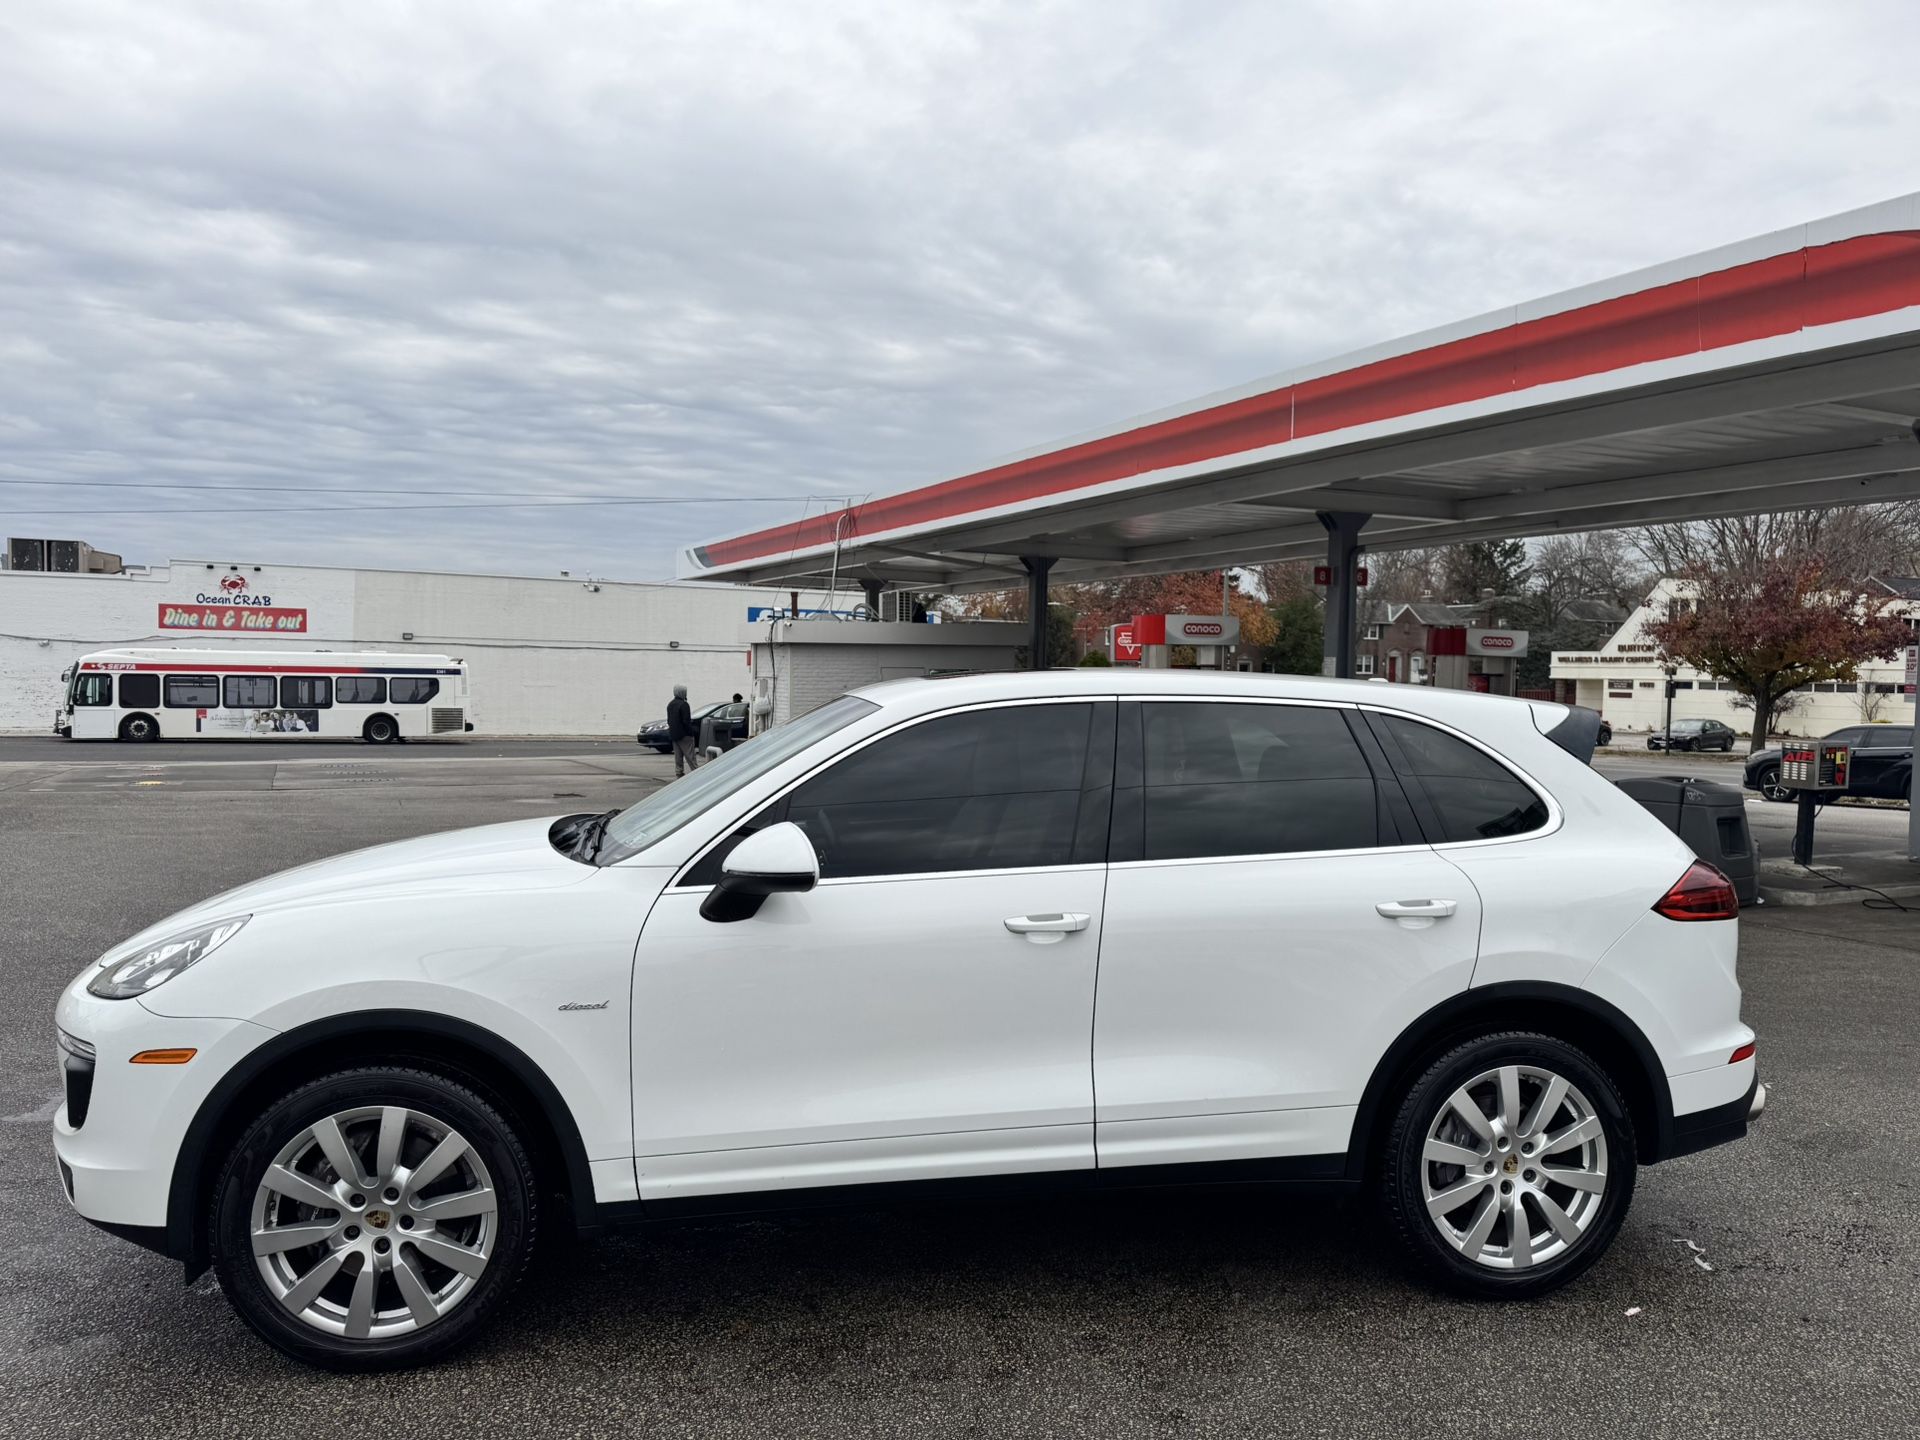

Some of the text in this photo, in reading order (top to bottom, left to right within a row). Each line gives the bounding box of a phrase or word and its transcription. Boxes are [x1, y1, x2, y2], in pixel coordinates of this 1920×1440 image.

[1319, 570, 1326, 581] 8
[196, 593, 272, 606] Ocean CRAB
[163, 608, 303, 630] Dine in & Take out
[1617, 644, 1655, 653] BURTON
[1557, 656, 1593, 664] WELLNESS
[1600, 656, 1625, 664] INJURY
[1625, 656, 1655, 664] CENTER
[1783, 751, 1815, 762] AIR
[558, 999, 610, 1011] diesel
